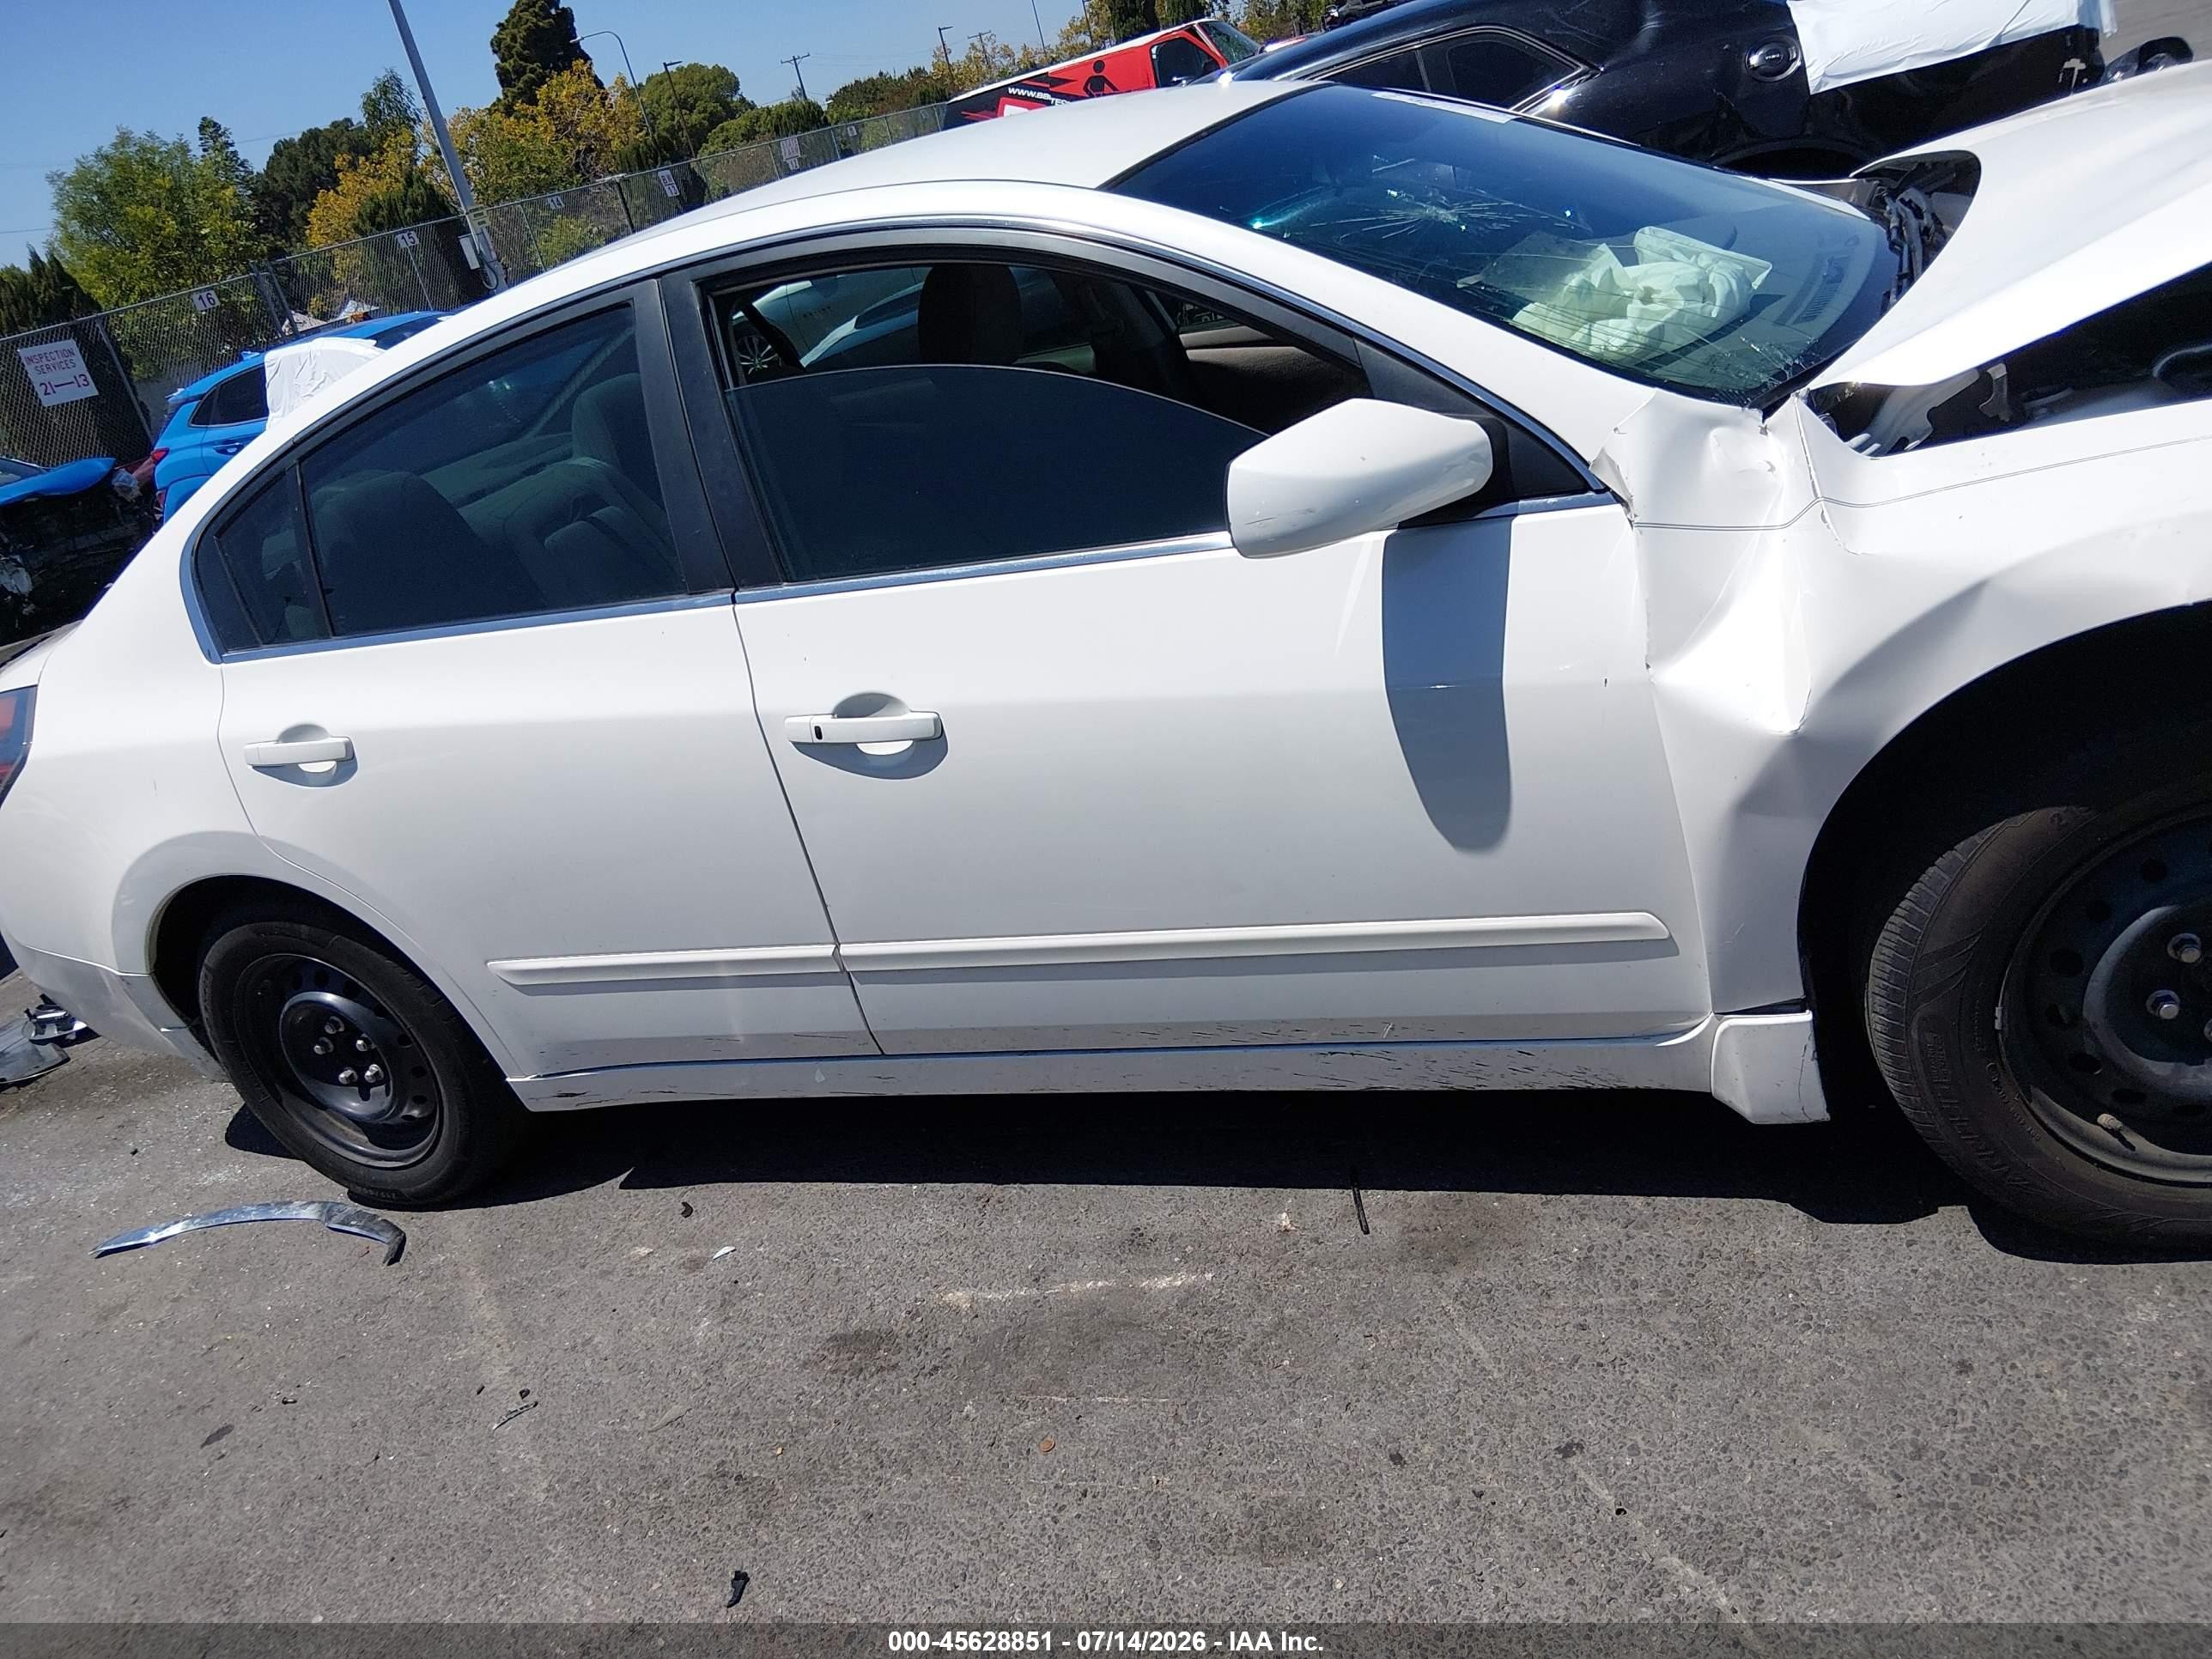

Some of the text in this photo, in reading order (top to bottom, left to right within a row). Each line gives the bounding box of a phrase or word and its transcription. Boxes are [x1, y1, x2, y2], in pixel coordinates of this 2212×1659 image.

[401, 232, 416, 246] 15
[198, 292, 216, 308] 16
[24, 347, 76, 367] INSPECTION
[34, 358, 76, 375] SERVICES
